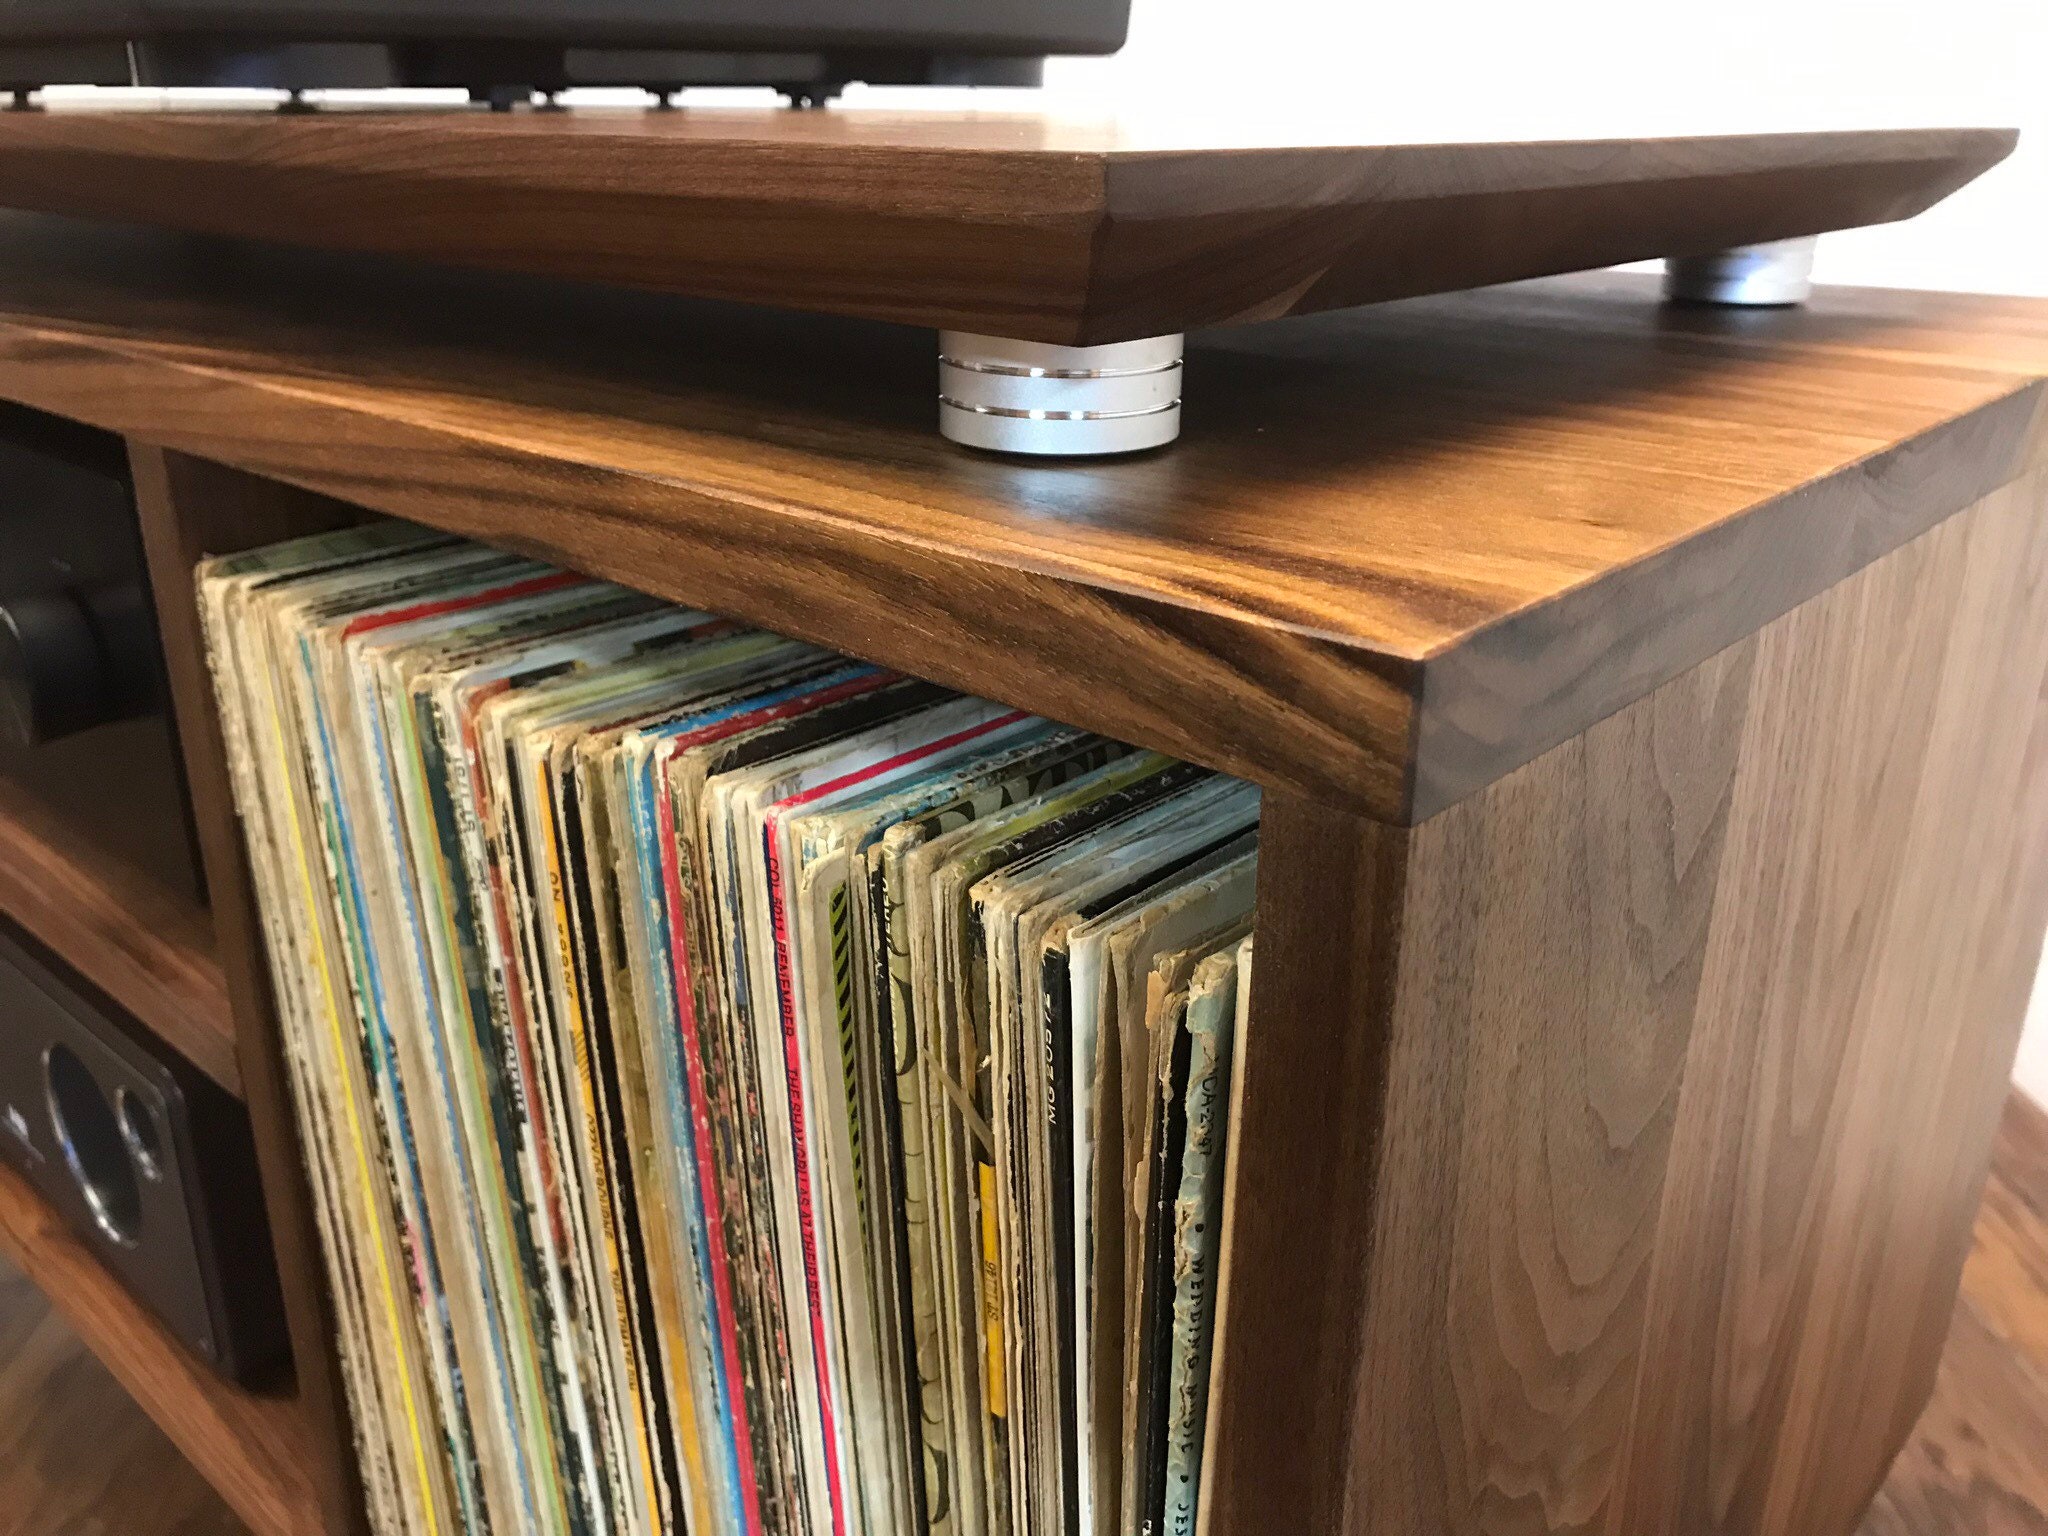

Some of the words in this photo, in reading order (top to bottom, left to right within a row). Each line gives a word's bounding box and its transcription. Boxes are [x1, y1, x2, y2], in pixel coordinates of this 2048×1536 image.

[773, 897, 785, 931] 5011
[776, 940, 795, 1037] REMEMBER
[788, 1068, 801, 1098] THE
[1047, 1085, 1058, 1126] MG
[804, 1231, 818, 1276] THEIR
[1187, 1253, 1205, 1370] WEDDING
